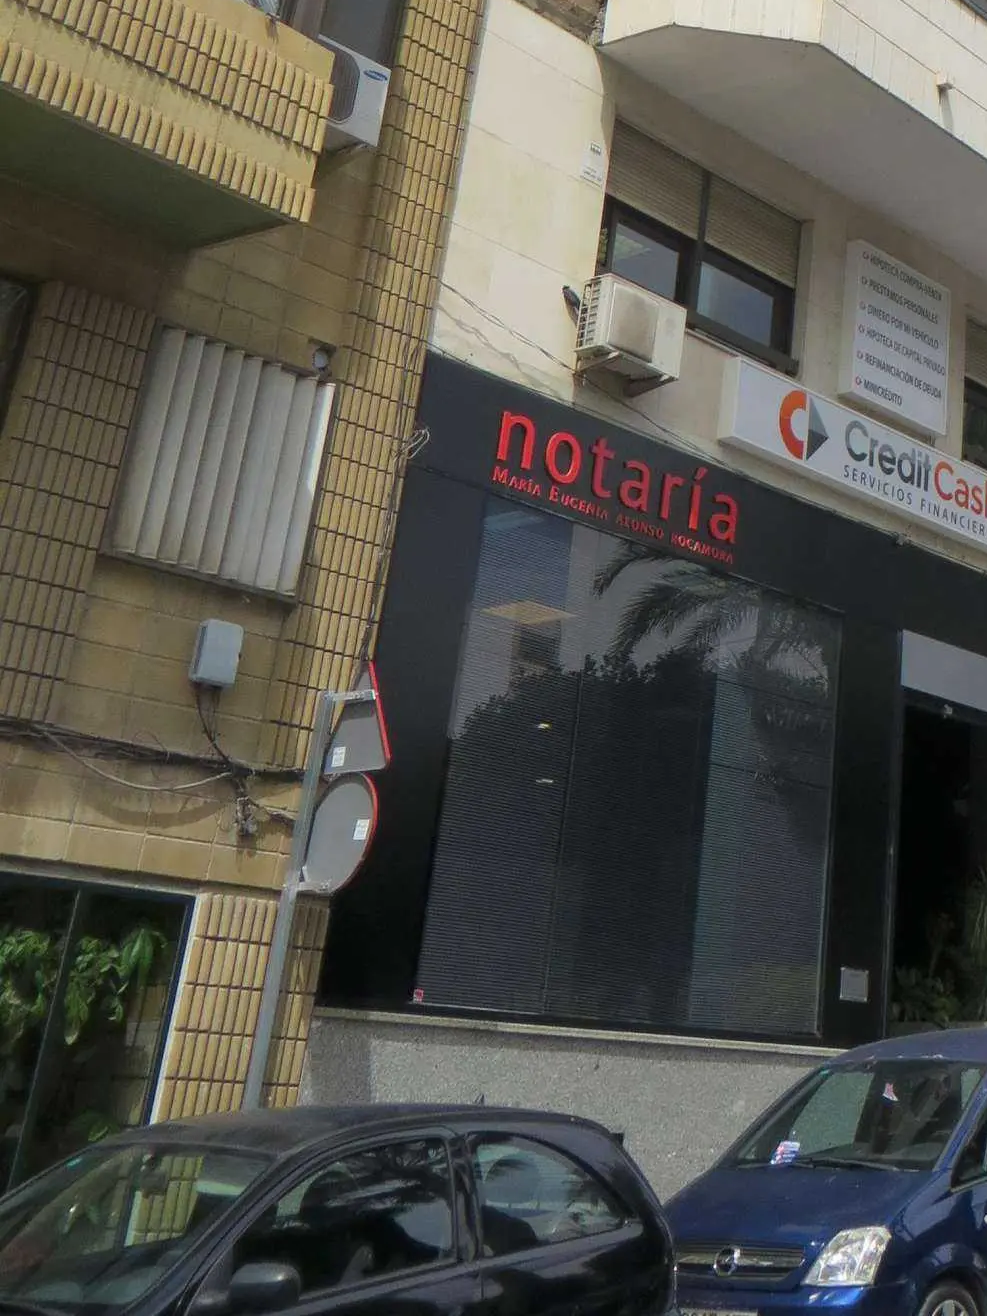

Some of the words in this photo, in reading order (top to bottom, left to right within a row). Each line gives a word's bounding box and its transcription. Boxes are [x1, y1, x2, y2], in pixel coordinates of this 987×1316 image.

[867, 303, 892, 327] DINERO
[891, 315, 903, 331] POR
[903, 293, 939, 325] PERSONALES
[866, 327, 894, 350] HIPOTECA
[893, 340, 902, 354] DE
[922, 355, 946, 376] PRIVADO
[914, 376, 923, 390] DE
[922, 380, 943, 399] DEUDA
[495, 410, 740, 545] notaría
[843, 464, 913, 506] SERVICIOS
[548, 486, 609, 521] EUGENIA
[670, 532, 735, 566] ROCAMORA
